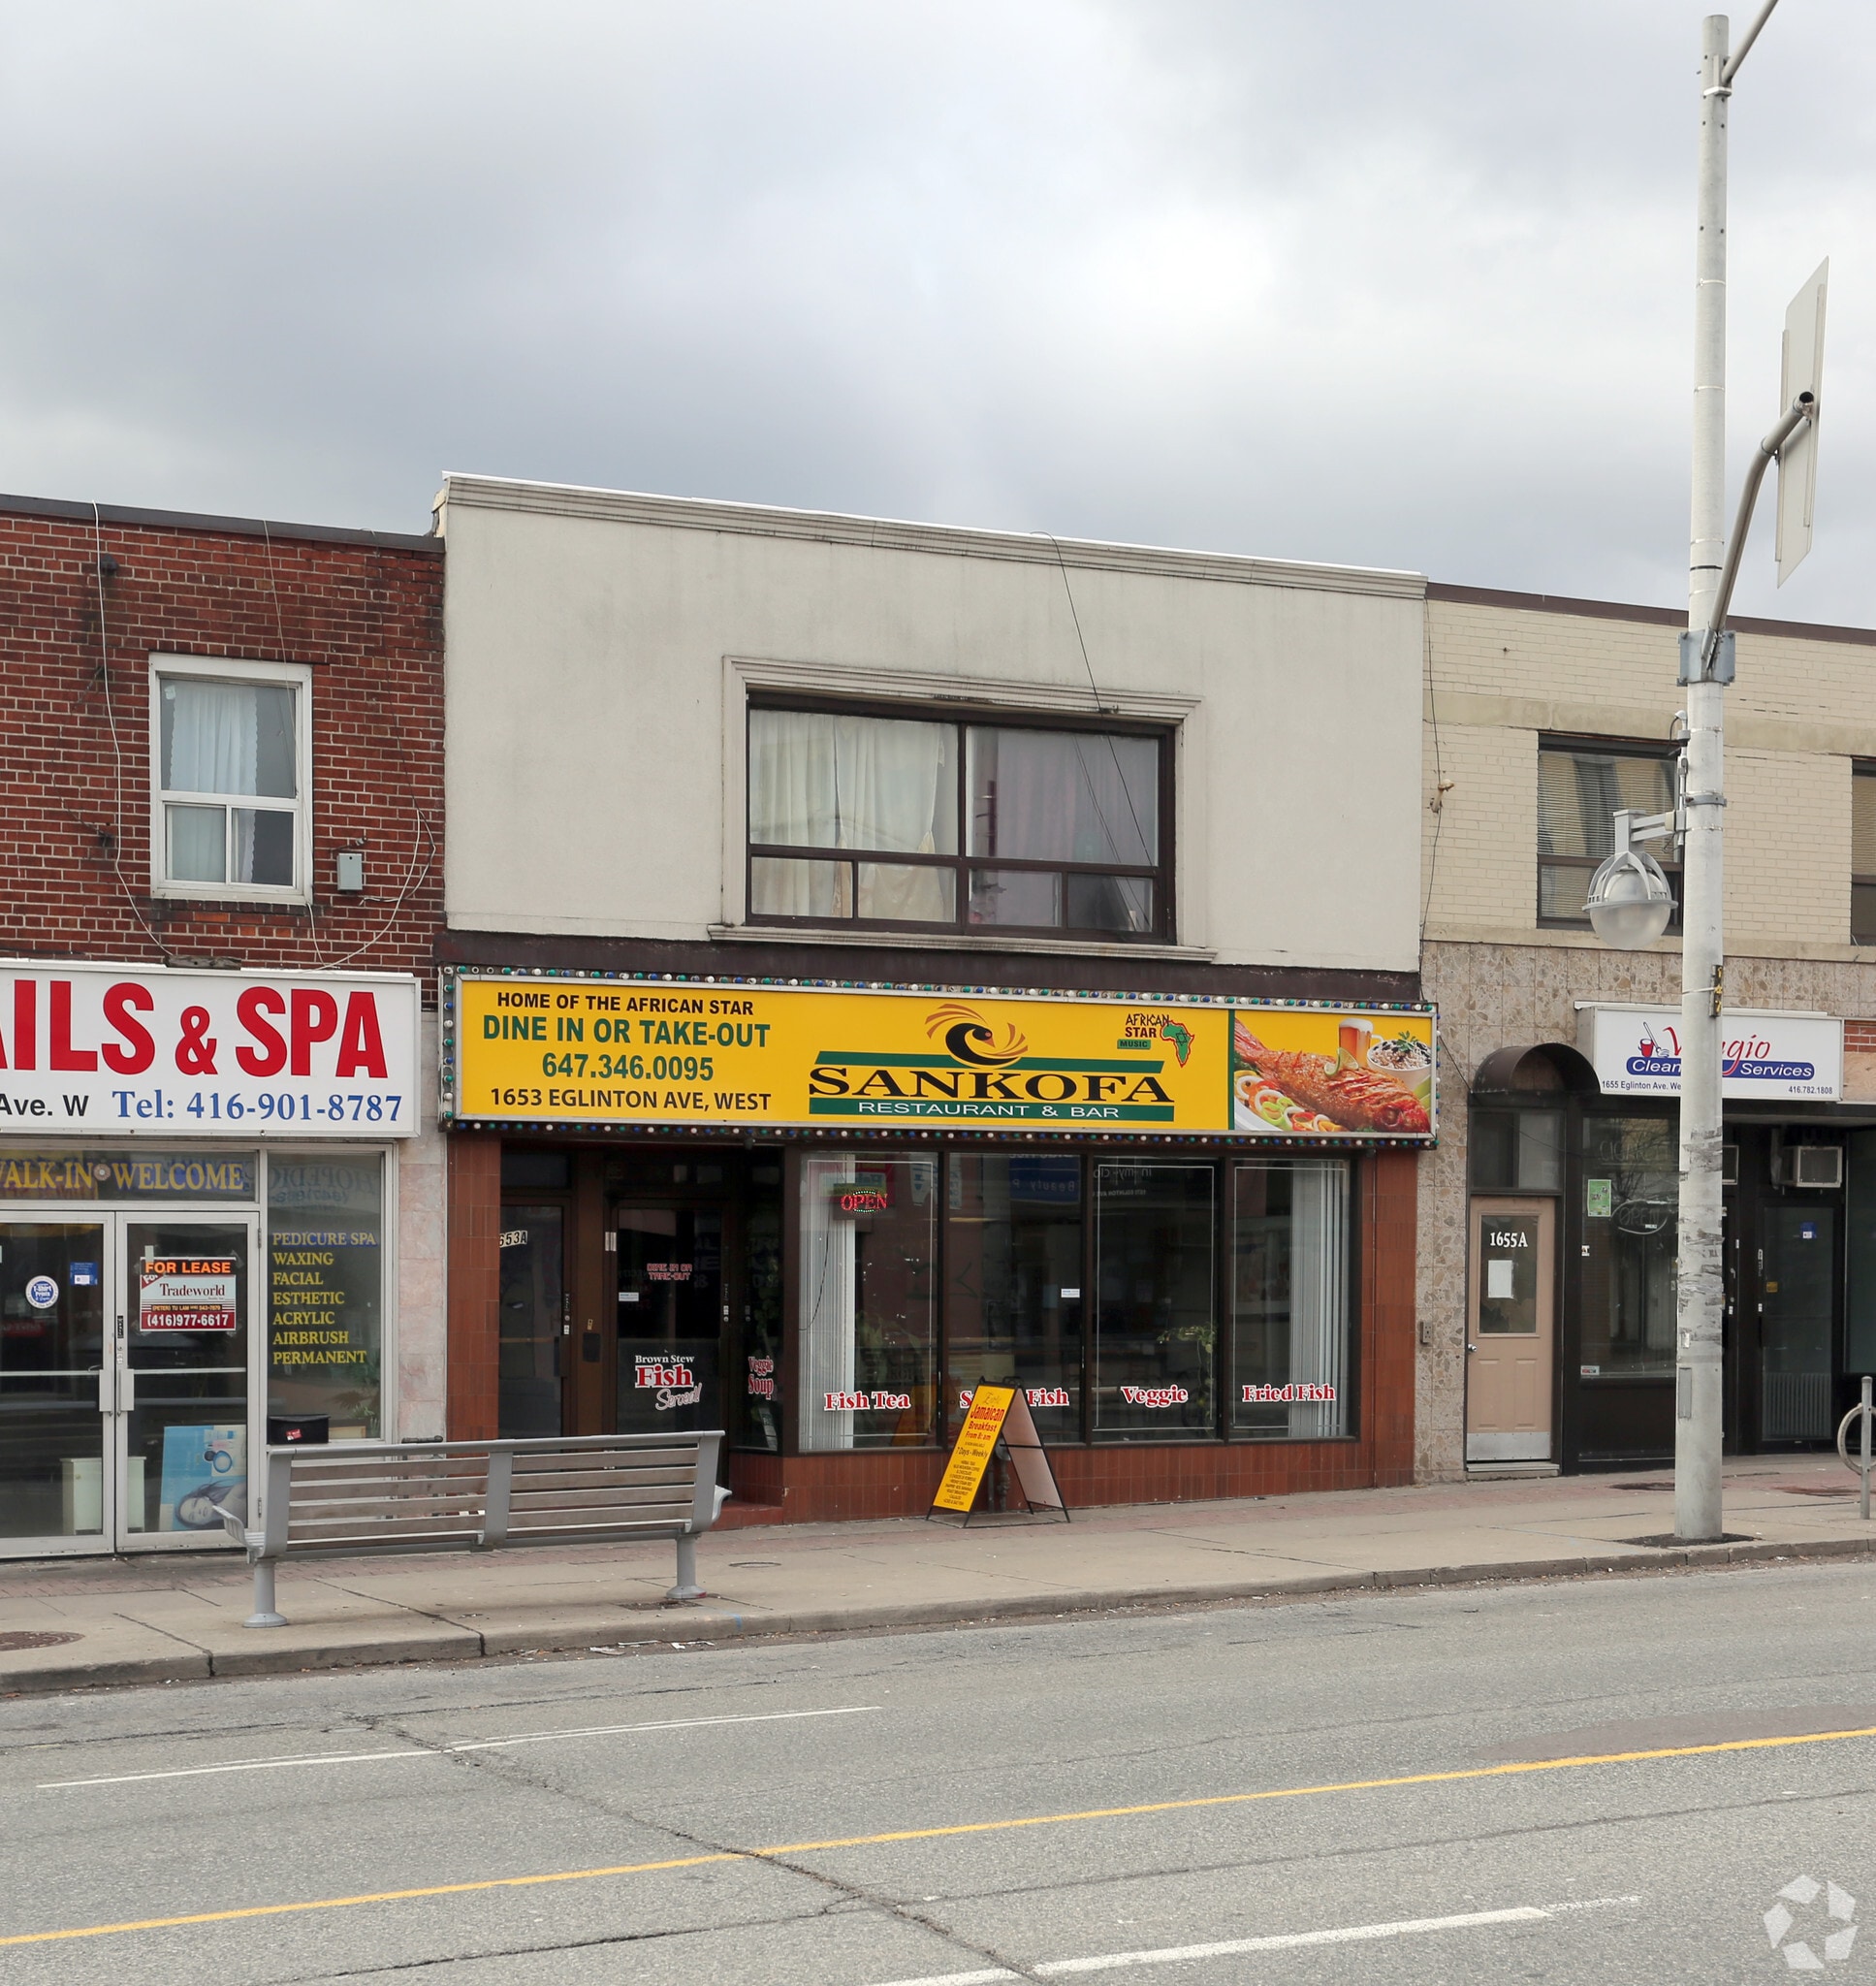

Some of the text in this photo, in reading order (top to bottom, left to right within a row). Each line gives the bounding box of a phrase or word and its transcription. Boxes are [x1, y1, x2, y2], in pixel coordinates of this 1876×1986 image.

[497, 992, 753, 1015] HOME OF THE AFRICAN STAR
[0, 979, 388, 1078] ILS & SPA
[1126, 1013, 1169, 1027] AFRICAN
[484, 1014, 771, 1047] DINE IN OR TAKE-OUT
[1125, 1027, 1157, 1038] STAR
[542, 1052, 714, 1081] 647.346.0095
[1632, 1059, 1812, 1076] Clean Services
[809, 1067, 1174, 1103] SANKOFA
[1621, 1080, 1651, 1090] Eglinton
[1788, 1085, 1832, 1094] 416.782.1808
[0, 1090, 401, 1122] Ave. W Tel: 416-901-8787
[491, 1088, 772, 1112] 1653 EGLINTON AVE, WEST
[859, 1102, 1119, 1118] RESTAURANT & BAR
[111, 1162, 243, 1191] WELCOME
[841, 1193, 888, 1211] OPEN
[272, 1233, 376, 1246] PEDICURE SPA
[1490, 1232, 1528, 1247] 1655A
[272, 1252, 334, 1265] WAXING
[145, 1262, 231, 1273] FOR LEASE
[272, 1272, 323, 1285] FACIAL
[160, 1283, 225, 1296] Tradeworld
[272, 1292, 344, 1304] ESTHETIC
[272, 1311, 334, 1325] ACRYLIC
[272, 1331, 349, 1345] AIRBRUSH
[273, 1350, 366, 1364] PERMANENT
[635, 1355, 694, 1363] Brown Stew
[748, 1355, 774, 1376] Veggie
[635, 1363, 694, 1388] Fish
[748, 1373, 774, 1399] Soup
[1242, 1382, 1336, 1402] Fried Fish
[824, 1391, 911, 1410] Fish Tea
[1027, 1388, 1069, 1406] Fish
[1121, 1385, 1188, 1408] Veggie
[970, 1404, 1004, 1422] Jamaican
[969, 1421, 997, 1432] Breakfast
